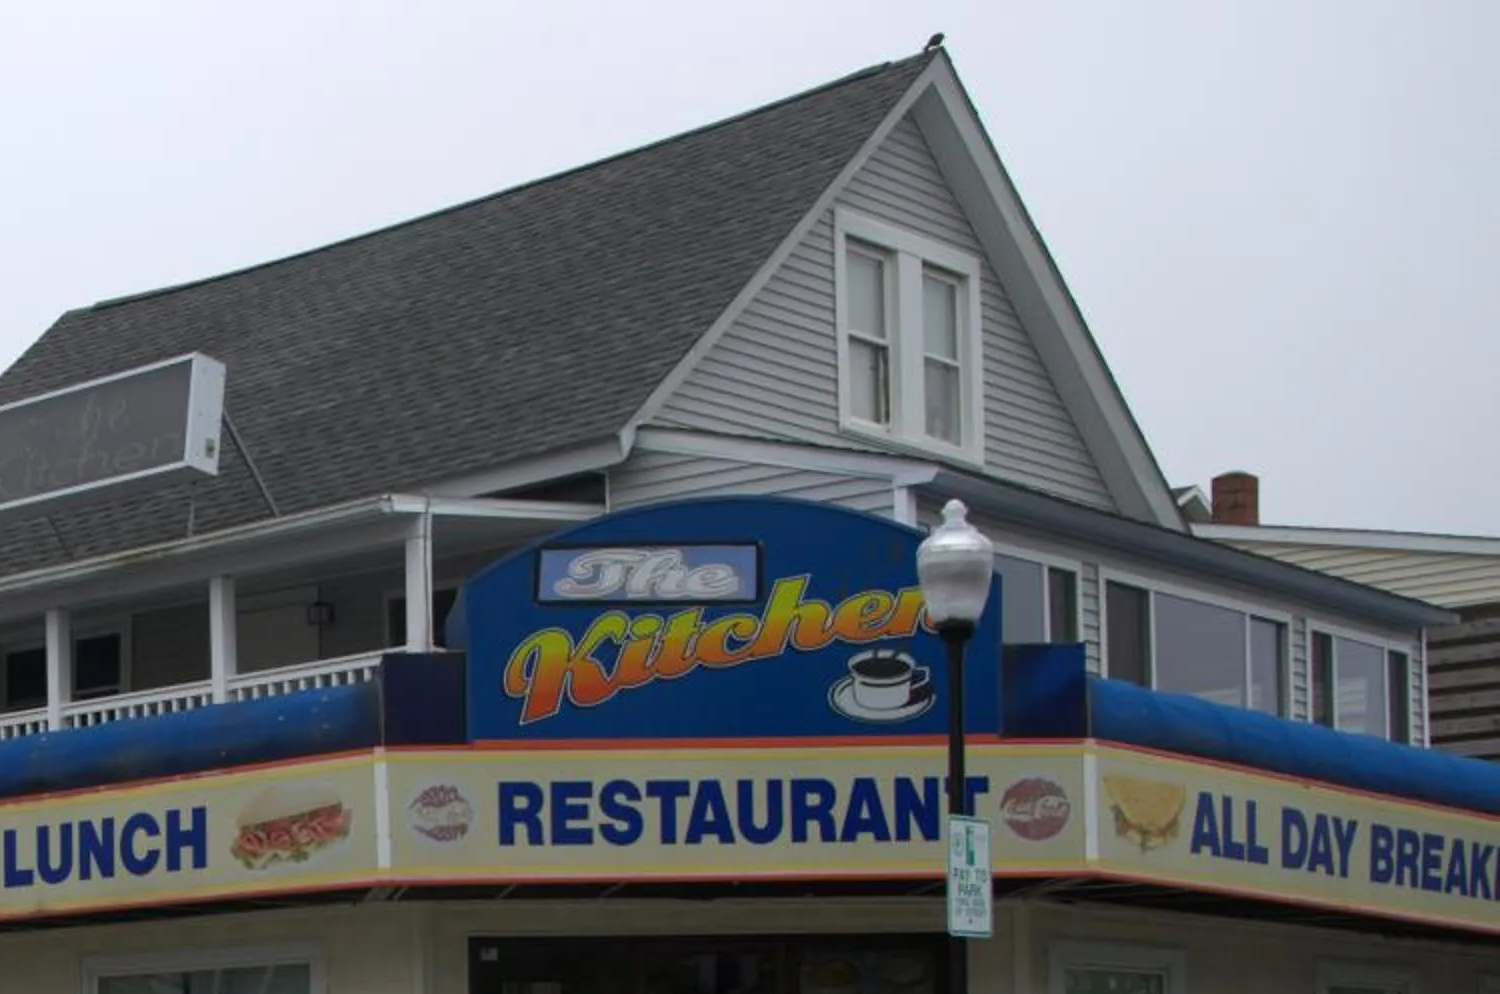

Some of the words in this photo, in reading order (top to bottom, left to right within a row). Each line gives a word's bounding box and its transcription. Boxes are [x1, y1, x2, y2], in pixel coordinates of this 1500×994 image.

[553, 548, 740, 598] The
[3, 805, 208, 888] LUNCH
[1190, 791, 1269, 866] ALL
[1281, 807, 1358, 878] DAY
[1369, 823, 1500, 901] BREAK
